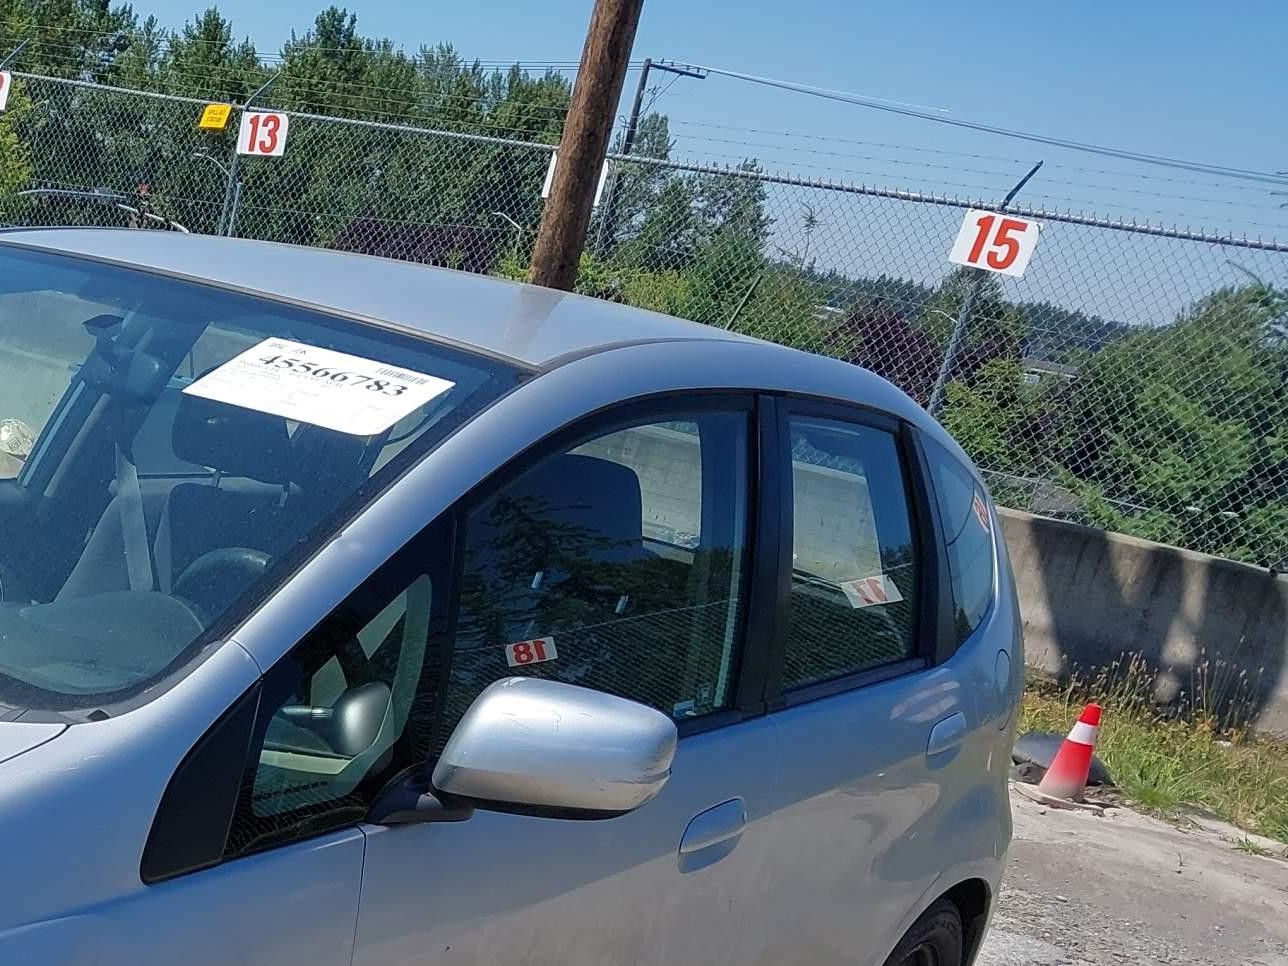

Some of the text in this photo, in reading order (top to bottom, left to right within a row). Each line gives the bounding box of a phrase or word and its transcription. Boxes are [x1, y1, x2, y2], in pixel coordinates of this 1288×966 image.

[248, 114, 281, 154] 13
[967, 214, 1030, 270] 15
[259, 354, 409, 396] 45566783
